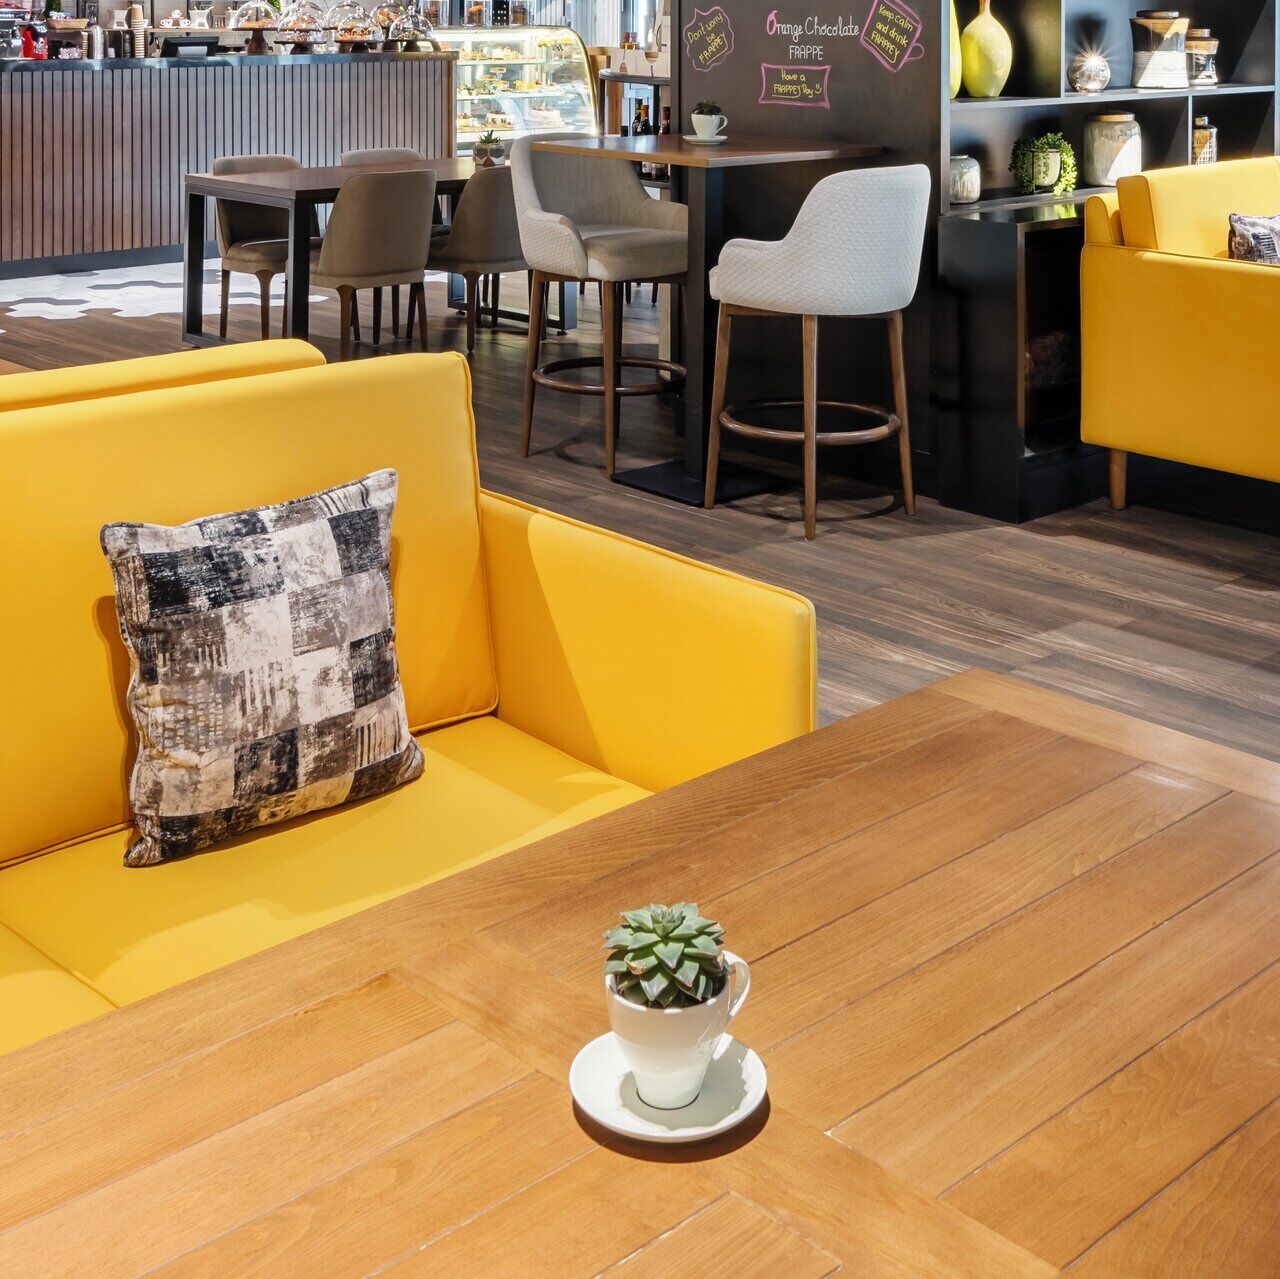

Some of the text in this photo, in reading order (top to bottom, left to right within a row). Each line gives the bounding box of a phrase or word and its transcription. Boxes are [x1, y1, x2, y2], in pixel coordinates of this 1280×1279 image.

[687, 13, 724, 44] Don't worry
[766, 9, 860, 42] Orange Chocolate
[878, 3, 913, 32] Keep calm
[699, 31, 729, 65] FRAPPEY
[705, 33, 716, 43] be
[870, 30, 901, 63] FRAPPEY
[875, 21, 909, 48] and drink
[789, 45, 824, 60] FRAPPE
[781, 69, 806, 82] Have a
[772, 83, 801, 98] FRAPPEY
